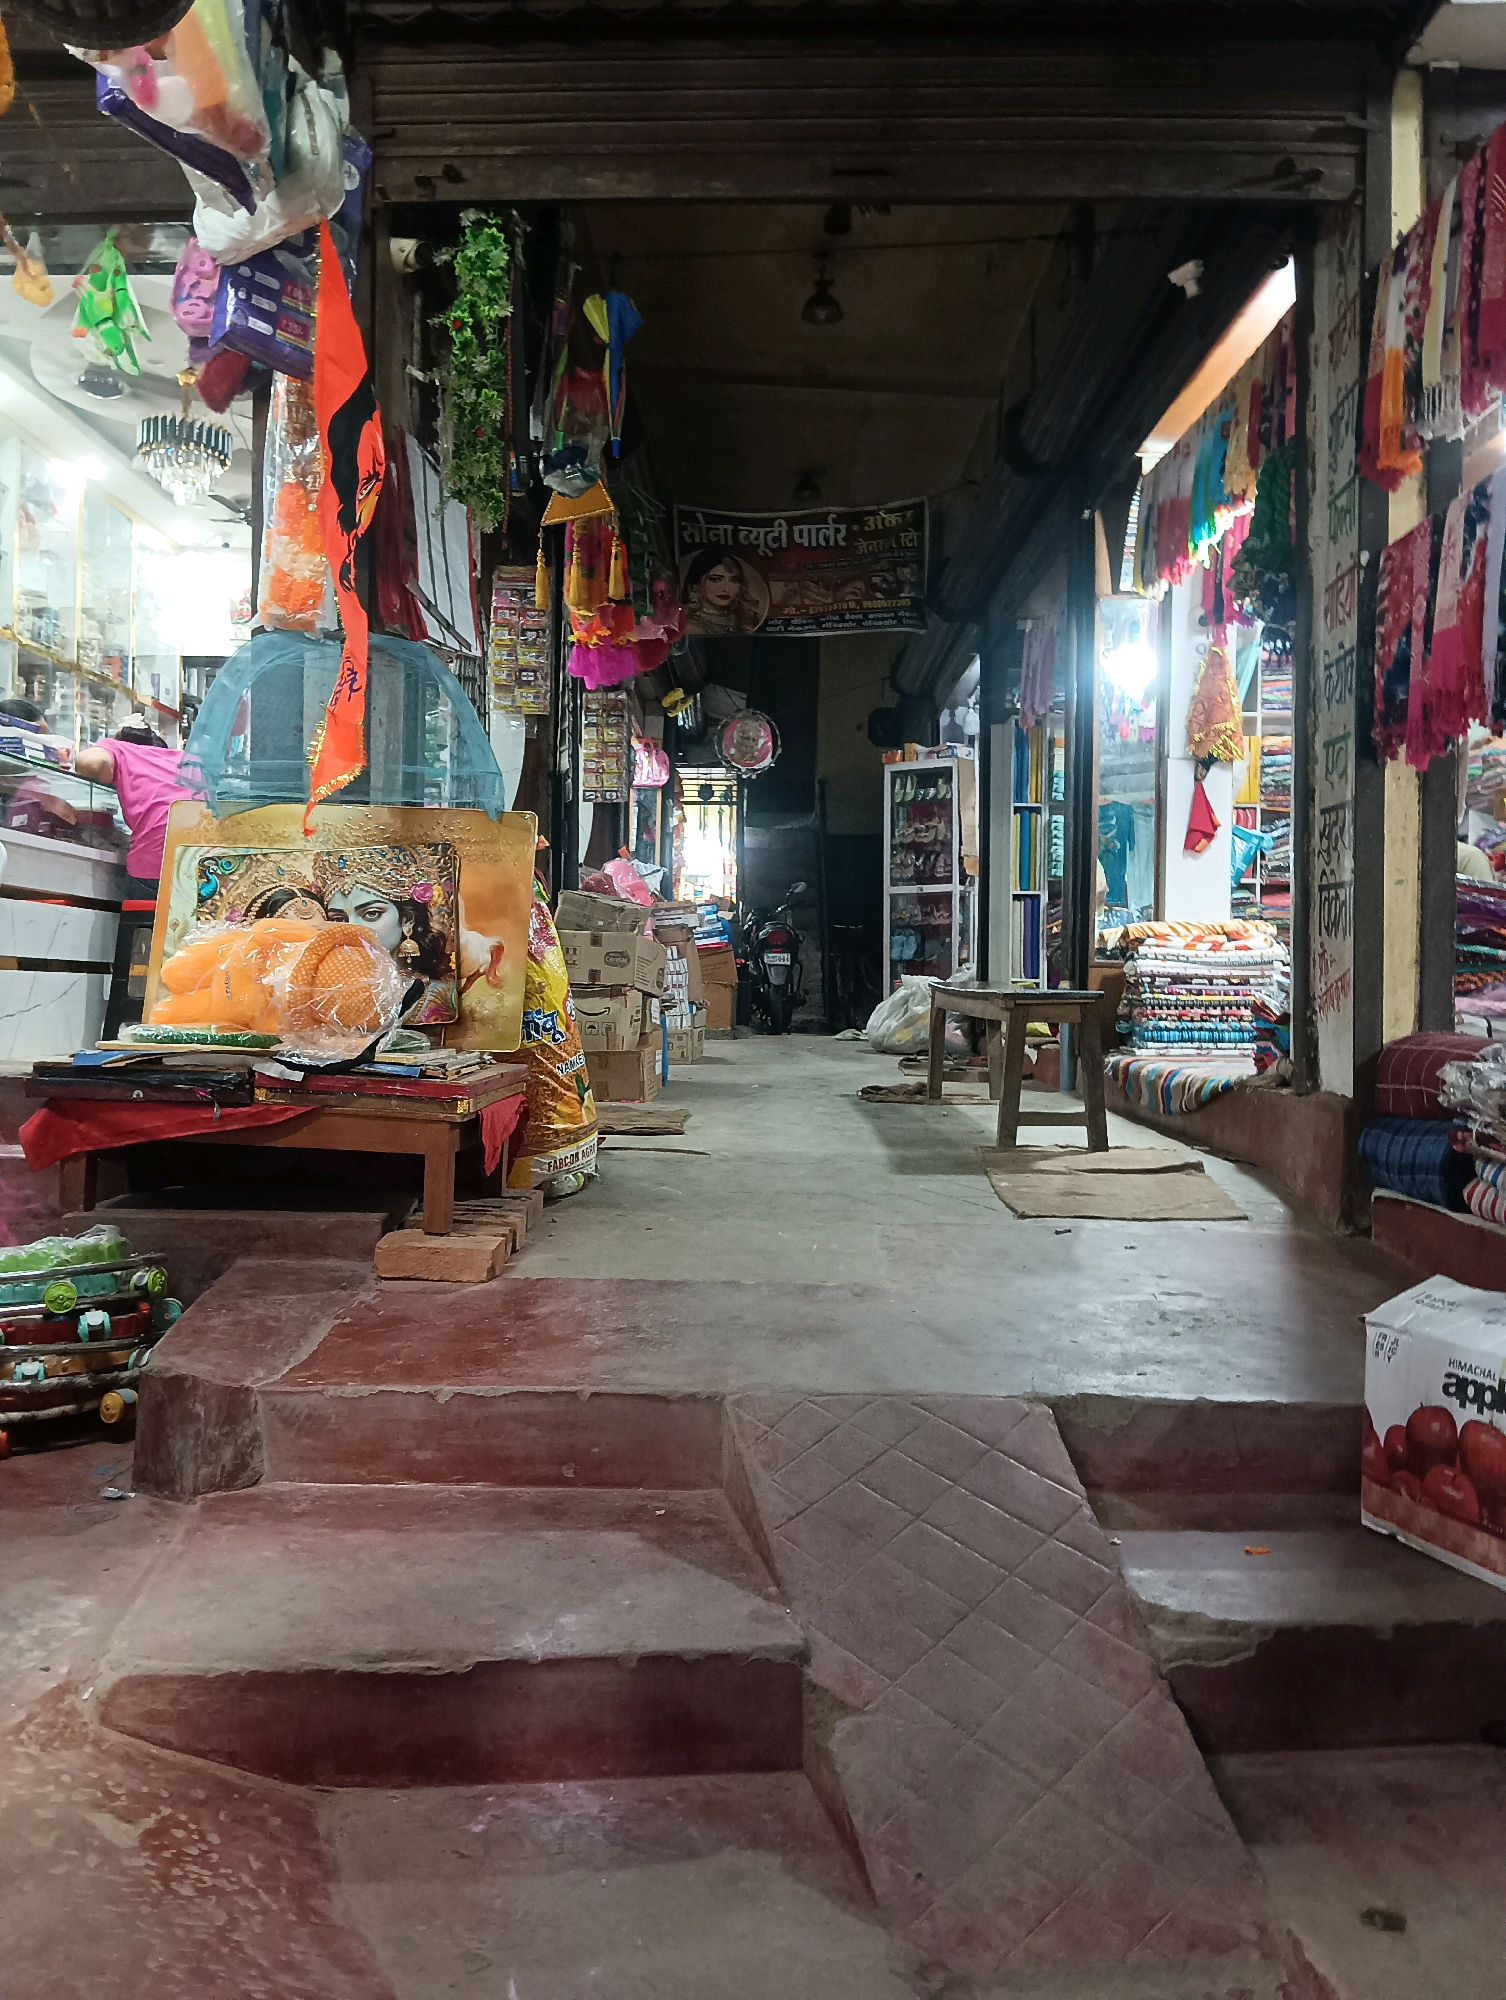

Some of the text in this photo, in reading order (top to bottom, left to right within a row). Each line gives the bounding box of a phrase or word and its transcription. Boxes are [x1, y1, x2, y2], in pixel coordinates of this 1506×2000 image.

[681, 513, 735, 545] सोना
[738, 518, 789, 557] ब्यूटी
[793, 513, 848, 547] पार्लर
[1448, 1357, 1497, 1382] HIMACHAL
[1442, 1370, 1506, 1415] appl
